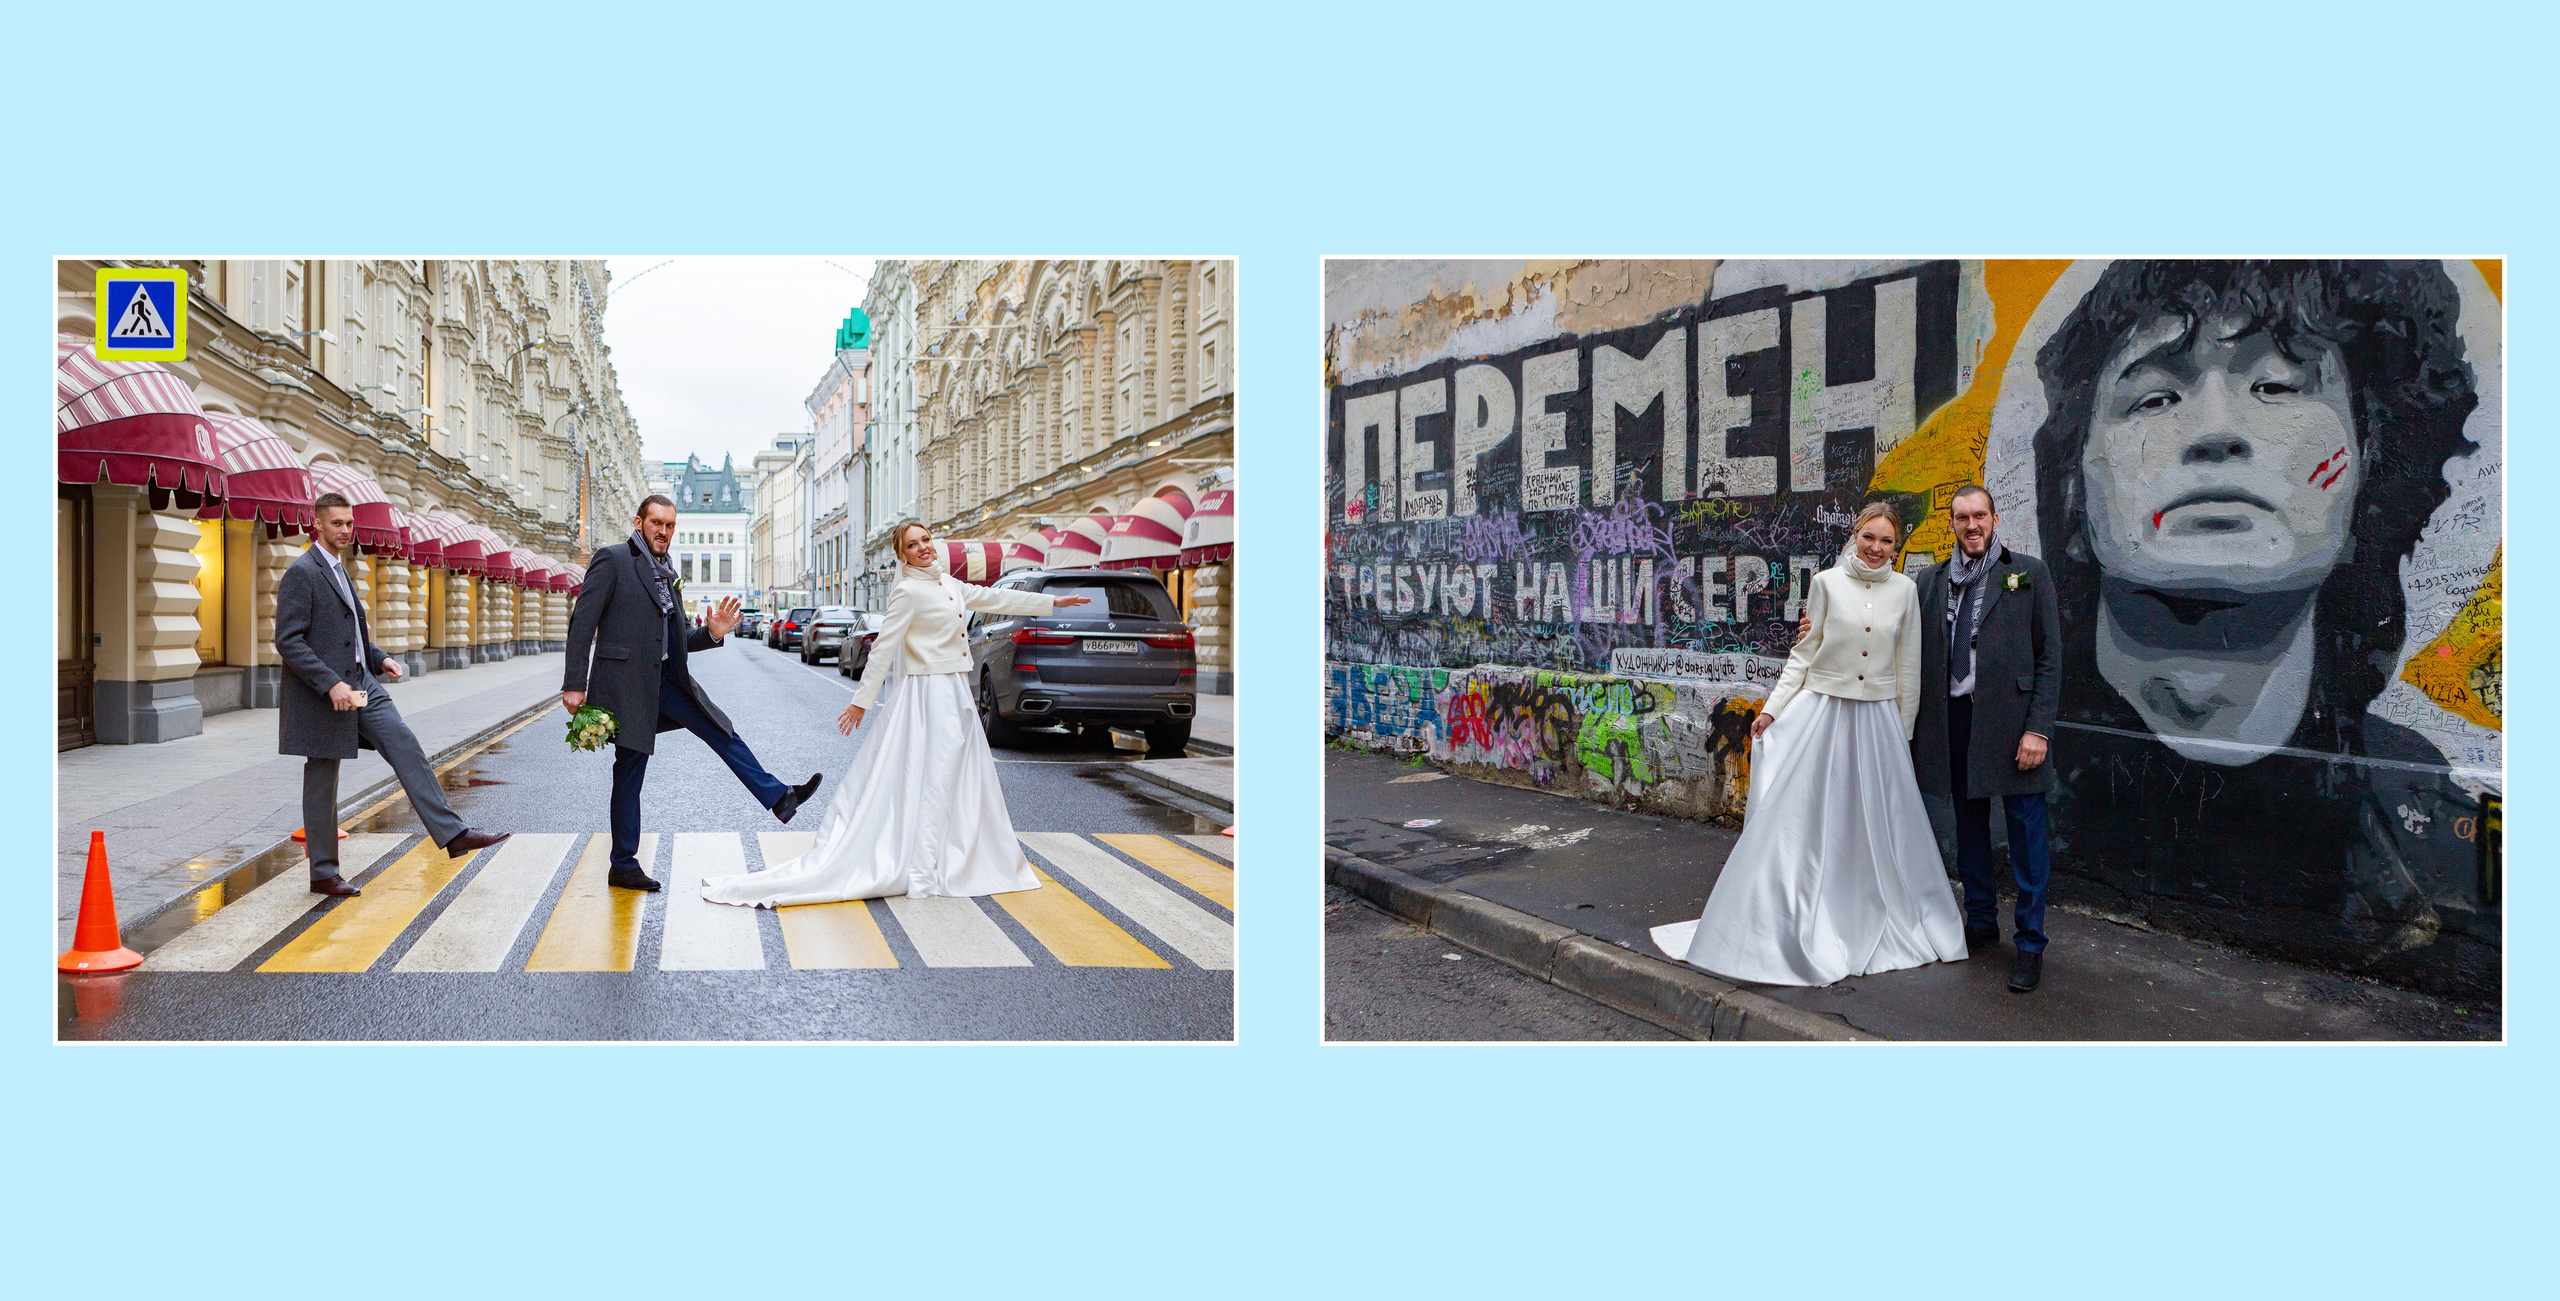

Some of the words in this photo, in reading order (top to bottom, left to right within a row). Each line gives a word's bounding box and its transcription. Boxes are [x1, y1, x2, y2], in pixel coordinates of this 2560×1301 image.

[1344, 277, 1917, 524] ПЕРЕМЕН
[1529, 499, 1538, 510] ПО
[1339, 564, 1498, 619] ТРЕБУЮТ
[1515, 558, 1653, 625] НАШИ
